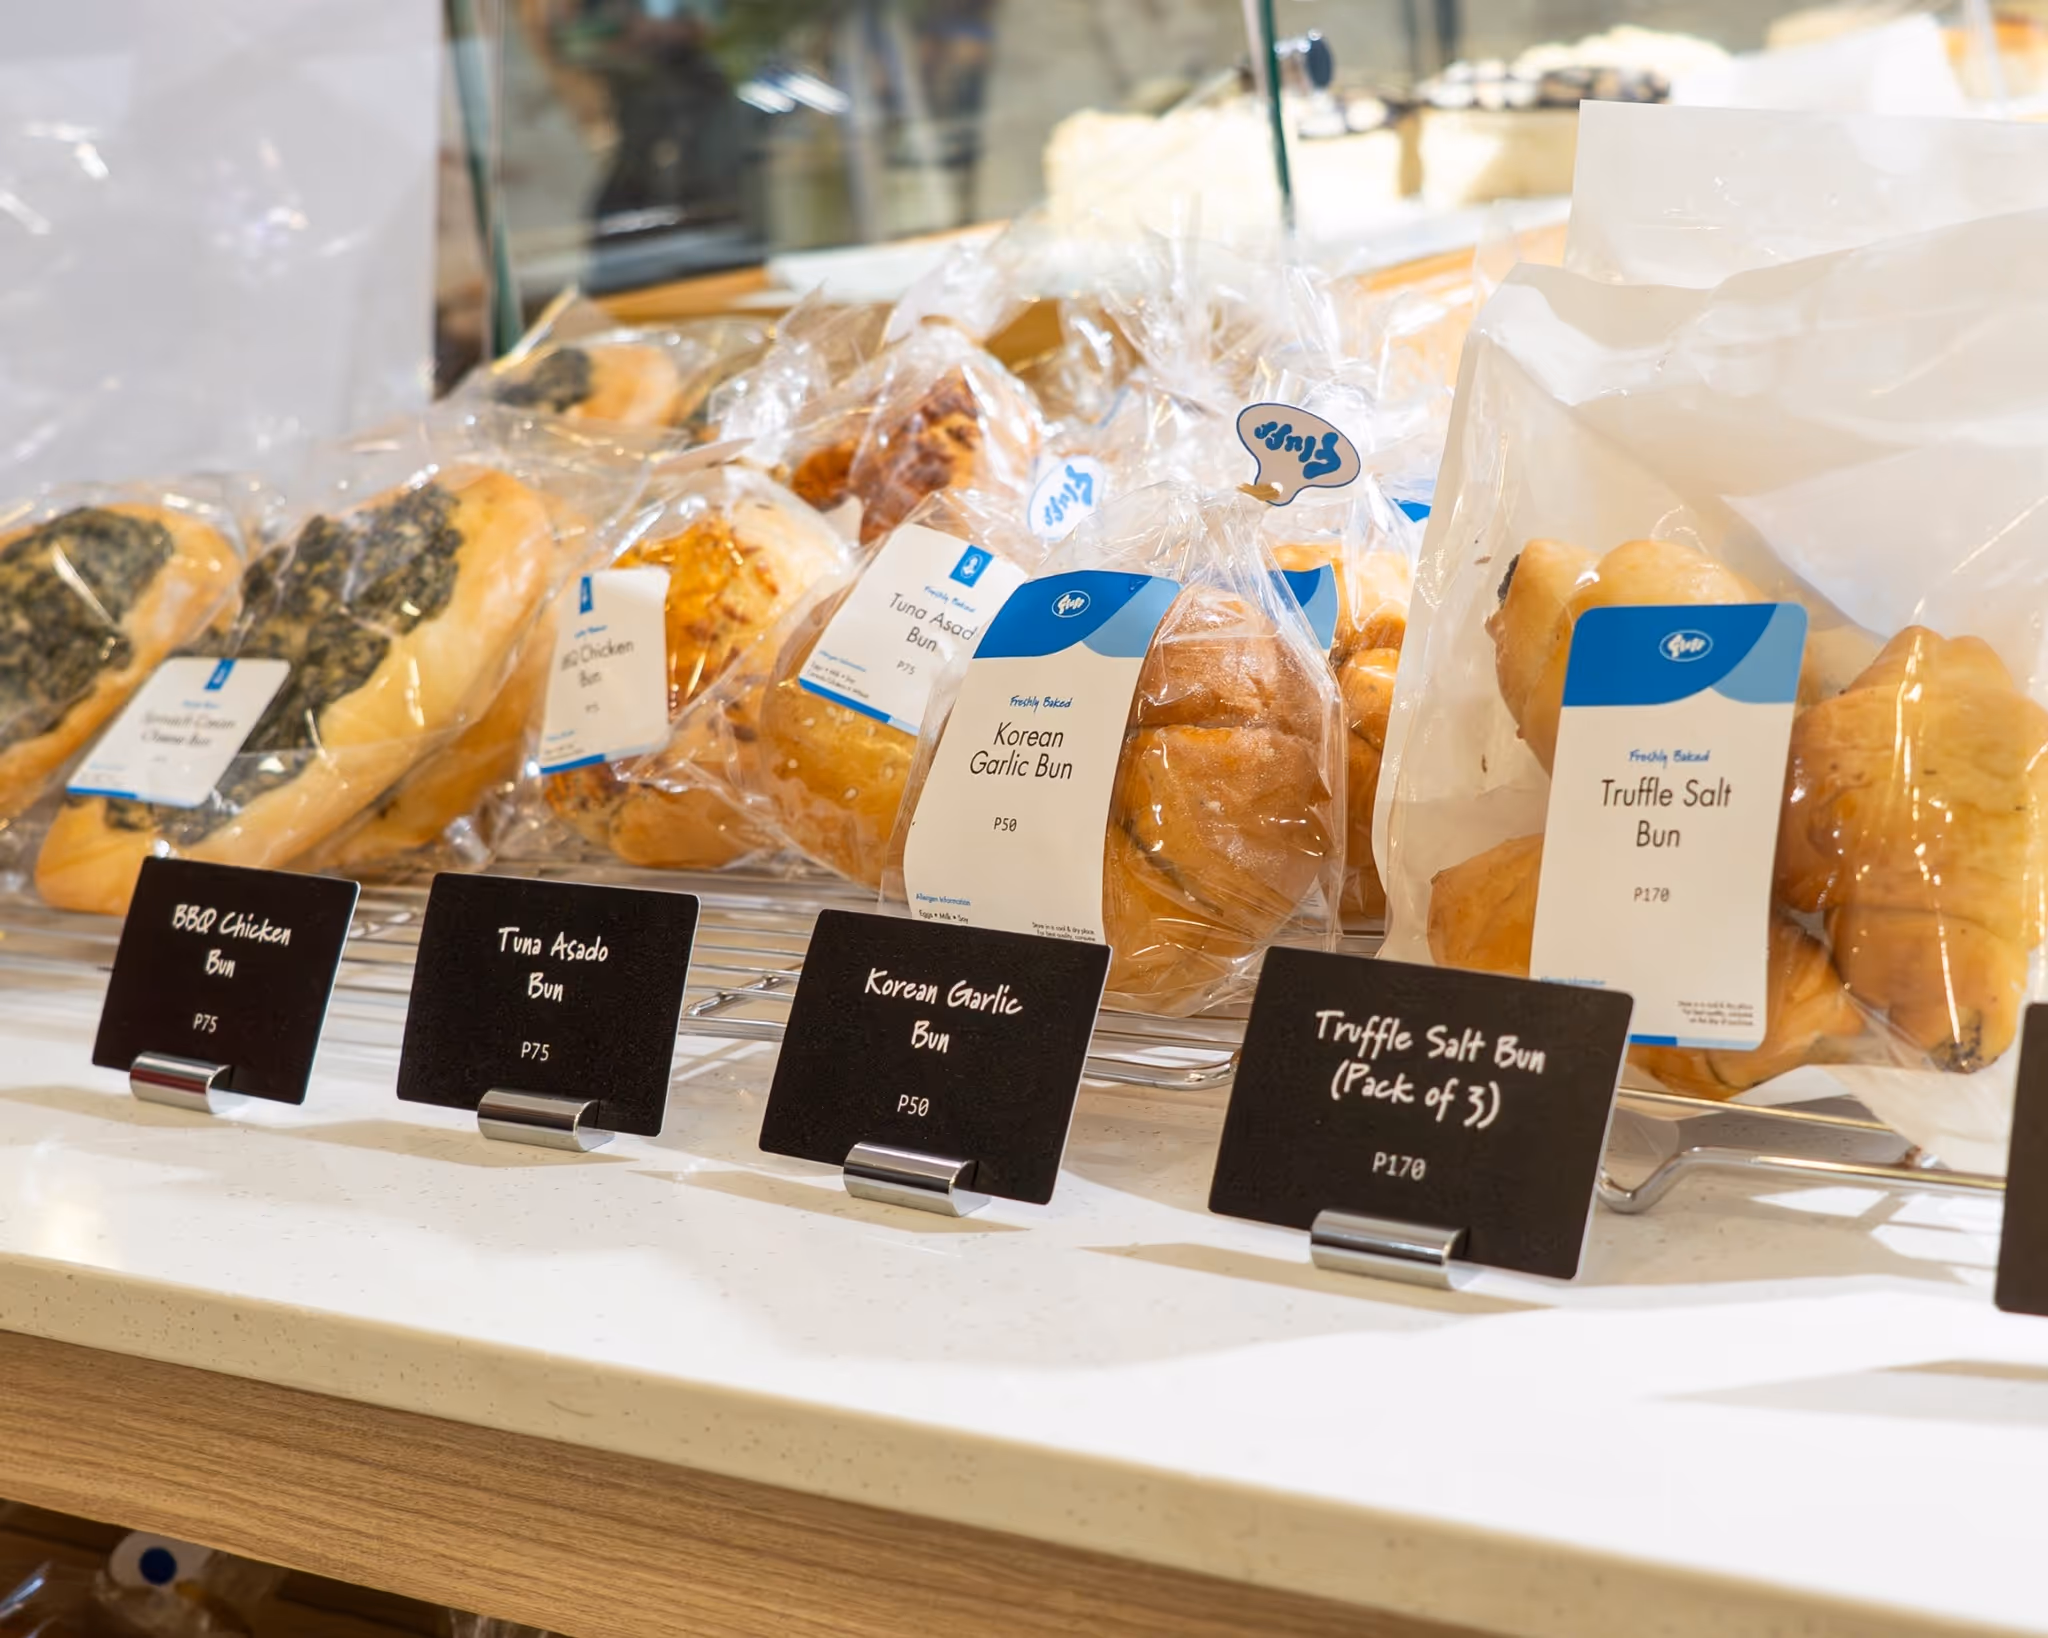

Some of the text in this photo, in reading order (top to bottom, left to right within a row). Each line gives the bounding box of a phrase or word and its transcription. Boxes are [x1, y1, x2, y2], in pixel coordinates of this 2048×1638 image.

[1254, 420, 1342, 479] Fluff
[1044, 464, 1093, 526] Fluff
[890, 592, 979, 641] Tuna Asad
[580, 638, 635, 663] Chicken
[906, 626, 937, 652] Bun
[1010, 695, 1073, 713] Freshly Baked
[993, 722, 1064, 748] Korean
[970, 750, 1073, 780] Garlic Bun
[1629, 748, 1711, 769] Freshly Baked
[1601, 776, 1732, 808] Truffle Salt
[993, 816, 1018, 832] P50
[1636, 820, 1681, 848] Bun
[1633, 887, 1670, 902] P170
[172, 903, 291, 946] BBQ Chicken
[498, 926, 609, 962] Tuna Asado
[205, 949, 236, 978] Bun
[527, 972, 563, 1003] Bun
[864, 967, 1023, 1015] Korean Garlic
[192, 1013, 218, 1034] P75
[911, 1020, 949, 1054] Bun
[520, 1041, 549, 1062] P75
[1315, 1009, 1546, 1074] Truffle Salt Bun
[896, 1094, 930, 1117] P50
[1331, 1059, 1501, 1130] (Pack of 3)
[1372, 1151, 1427, 1181] P170
